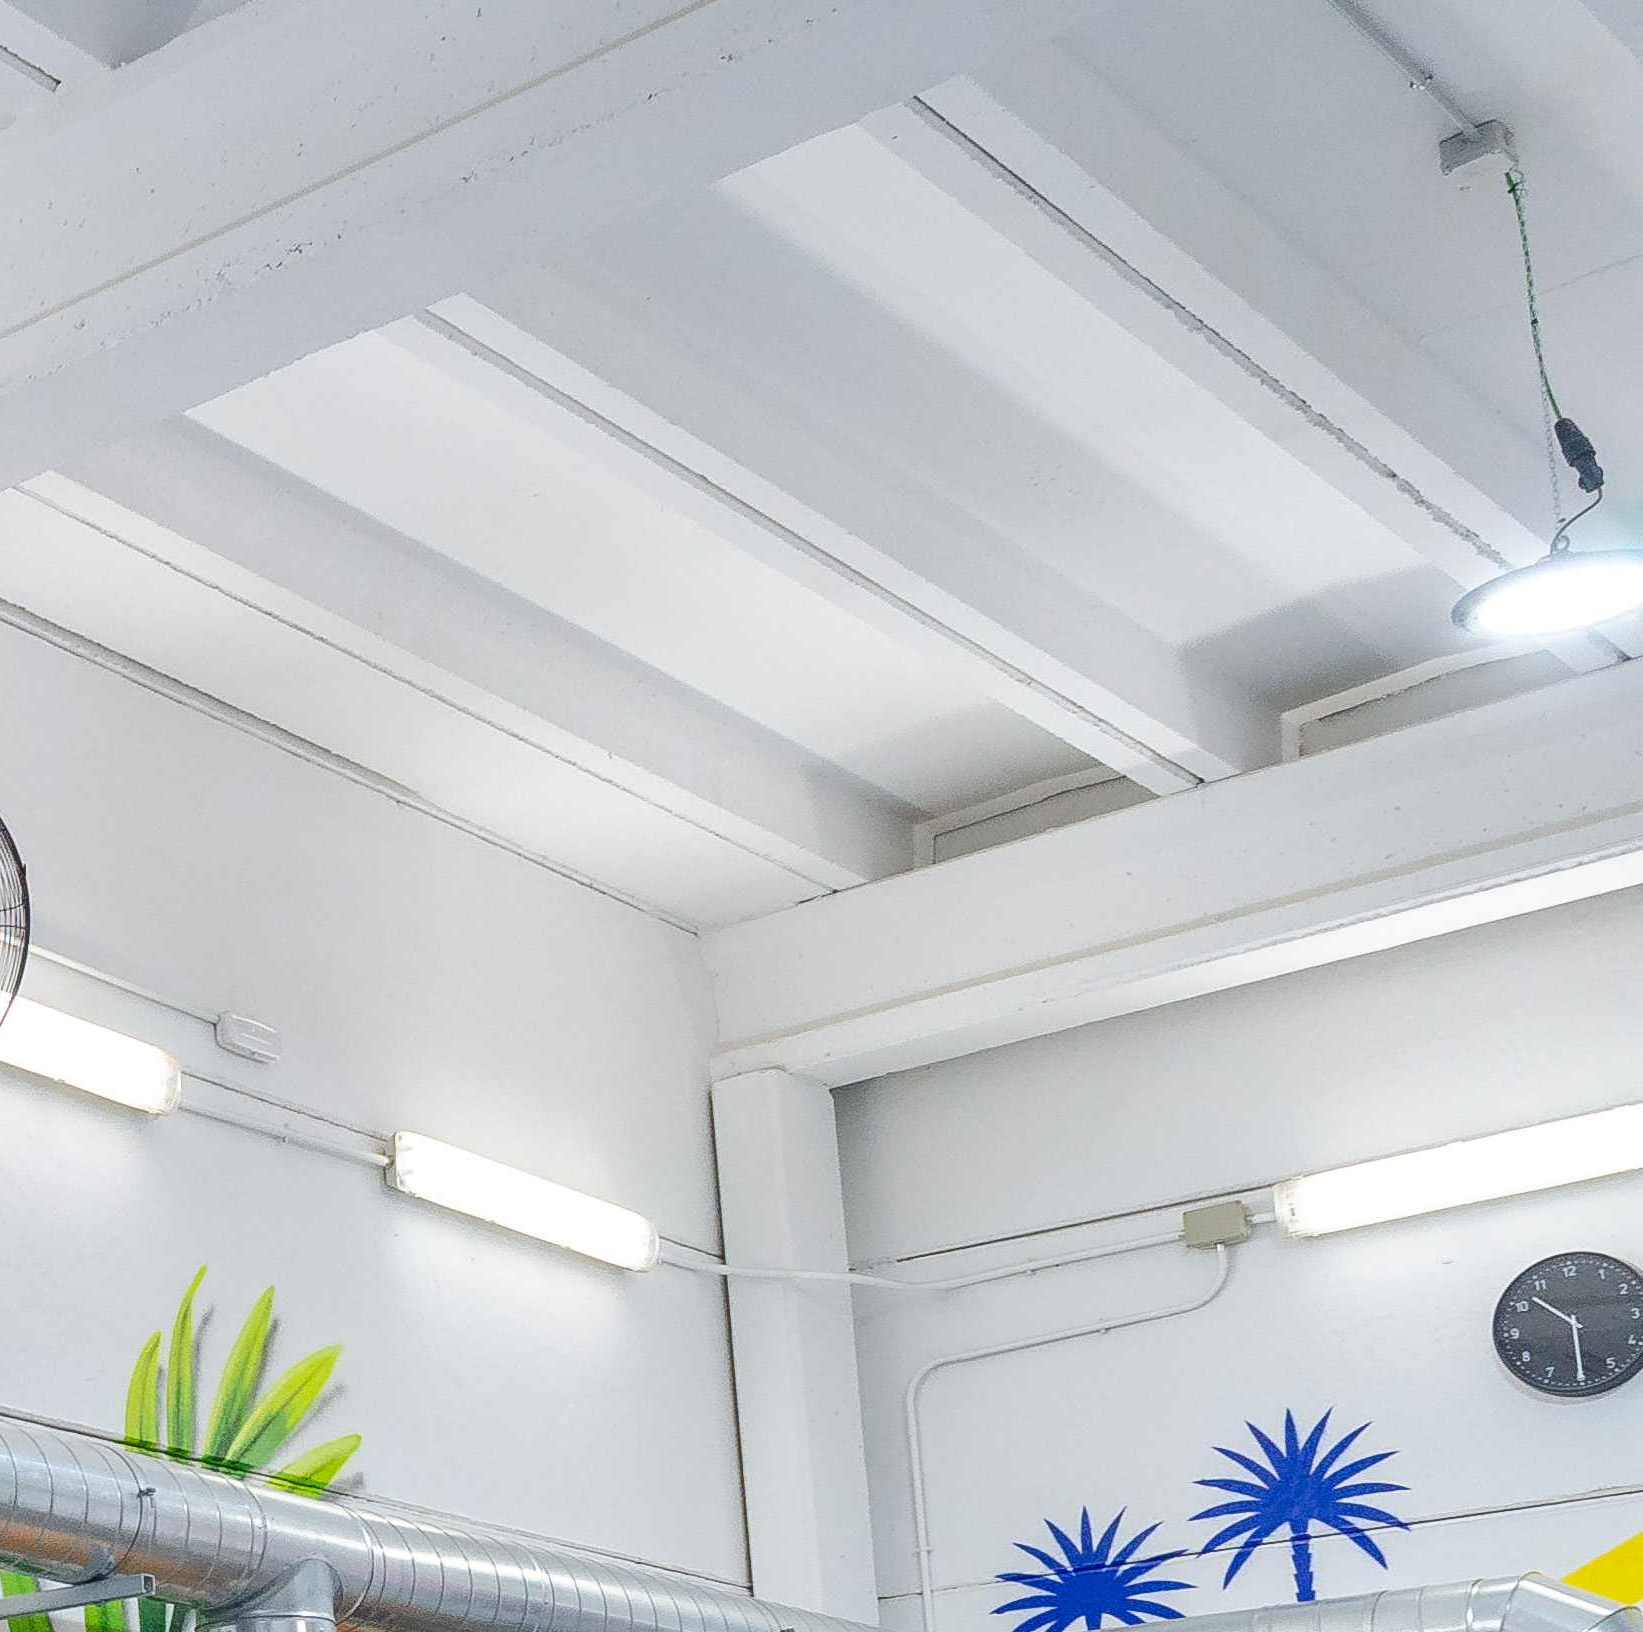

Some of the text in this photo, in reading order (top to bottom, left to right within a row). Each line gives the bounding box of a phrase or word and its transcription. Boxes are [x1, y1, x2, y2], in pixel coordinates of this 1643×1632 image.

[1562, 1265, 1577, 1277] 12
[1598, 1268, 1605, 1280] 1
[1534, 1279, 1547, 1291] 11
[1619, 1283, 1629, 1295] 2
[1515, 1301, 1529, 1313] 10
[1630, 1307, 1641, 1319] 3
[1510, 1328, 1520, 1340] 9
[1627, 1334, 1637, 1345] 4
[1522, 1351, 1531, 1363] 8
[1605, 1357, 1615, 1369] 5
[1545, 1366, 1555, 1378] 7
